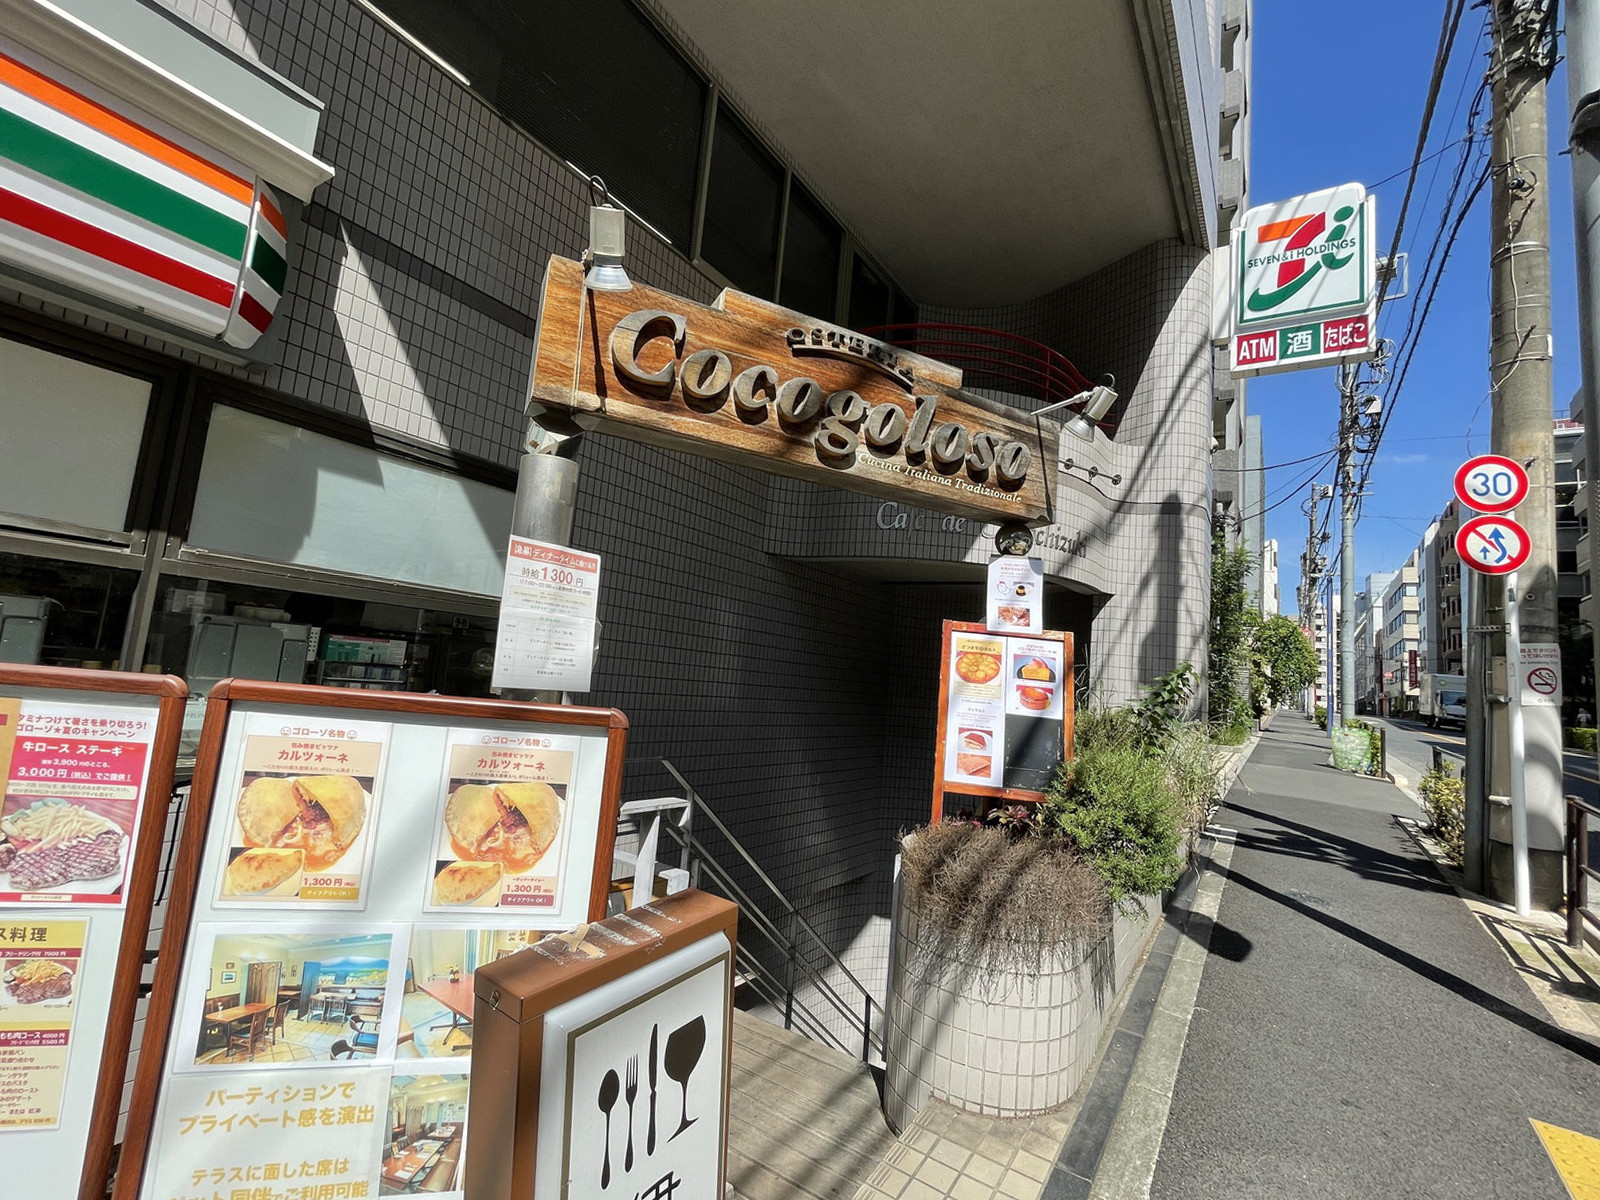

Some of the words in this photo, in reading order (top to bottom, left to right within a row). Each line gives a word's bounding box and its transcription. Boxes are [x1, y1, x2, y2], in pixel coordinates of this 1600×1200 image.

[1296, 237, 1356, 259] HOLDINGS
[1286, 329, 1313, 355] 酒
[1325, 321, 1367, 348] たばこ
[1238, 335, 1275, 361] ATM
[609, 309, 1032, 483] Cocogoloso
[857, 453, 900, 473] Cucina
[904, 466, 952, 487] Italiana
[954, 478, 1022, 503] Tradizionale
[1472, 472, 1512, 497] 30
[521, 566, 540, 579] 時給
[541, 566, 573, 585] 1300
[576, 577, 584, 587] 円
[278, 749, 349, 764] カルツォーネ
[477, 758, 545, 772] カルツォーネ
[303, 878, 332, 887] 1,300
[506, 885, 532, 893] 1,300
[205, 1082, 355, 1107] パーティションで
[179, 1105, 375, 1136] プライベート感を演出
[192, 1158, 350, 1186] テラスに面した席は
